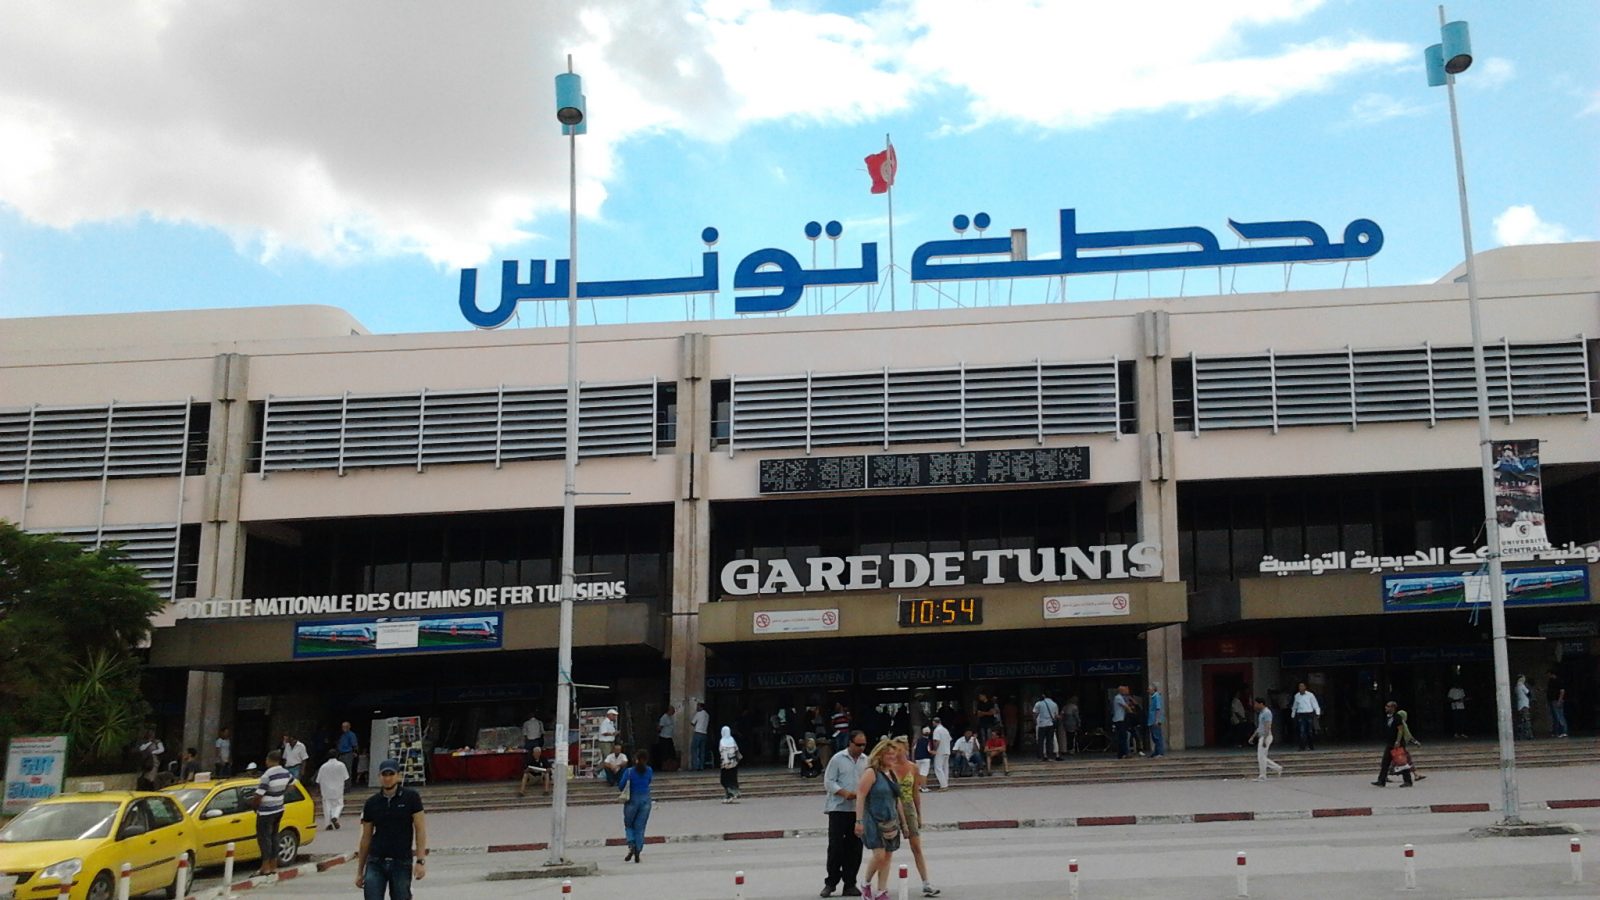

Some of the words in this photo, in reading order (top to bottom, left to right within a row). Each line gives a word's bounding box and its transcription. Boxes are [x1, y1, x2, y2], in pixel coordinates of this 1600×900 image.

[911, 207, 1384, 283] محطة
[459, 220, 878, 329] تونس
[720, 555, 882, 595] GARE
[888, 551, 965, 589] DE
[972, 541, 1163, 584] TUNIS
[1259, 551, 1346, 577] التونسية
[1350, 547, 1444, 574] الحديدية
[254, 595, 352, 616] NATIONALE
[355, 593, 390, 612] DES
[393, 588, 471, 610] CHEMINS
[474, 587, 497, 606] DE
[500, 585, 533, 605] FER
[911, 599, 974, 624] 10:54
[757, 671, 845, 687] WILLKOMMEN
[986, 662, 1057, 676] BIENVENUE
